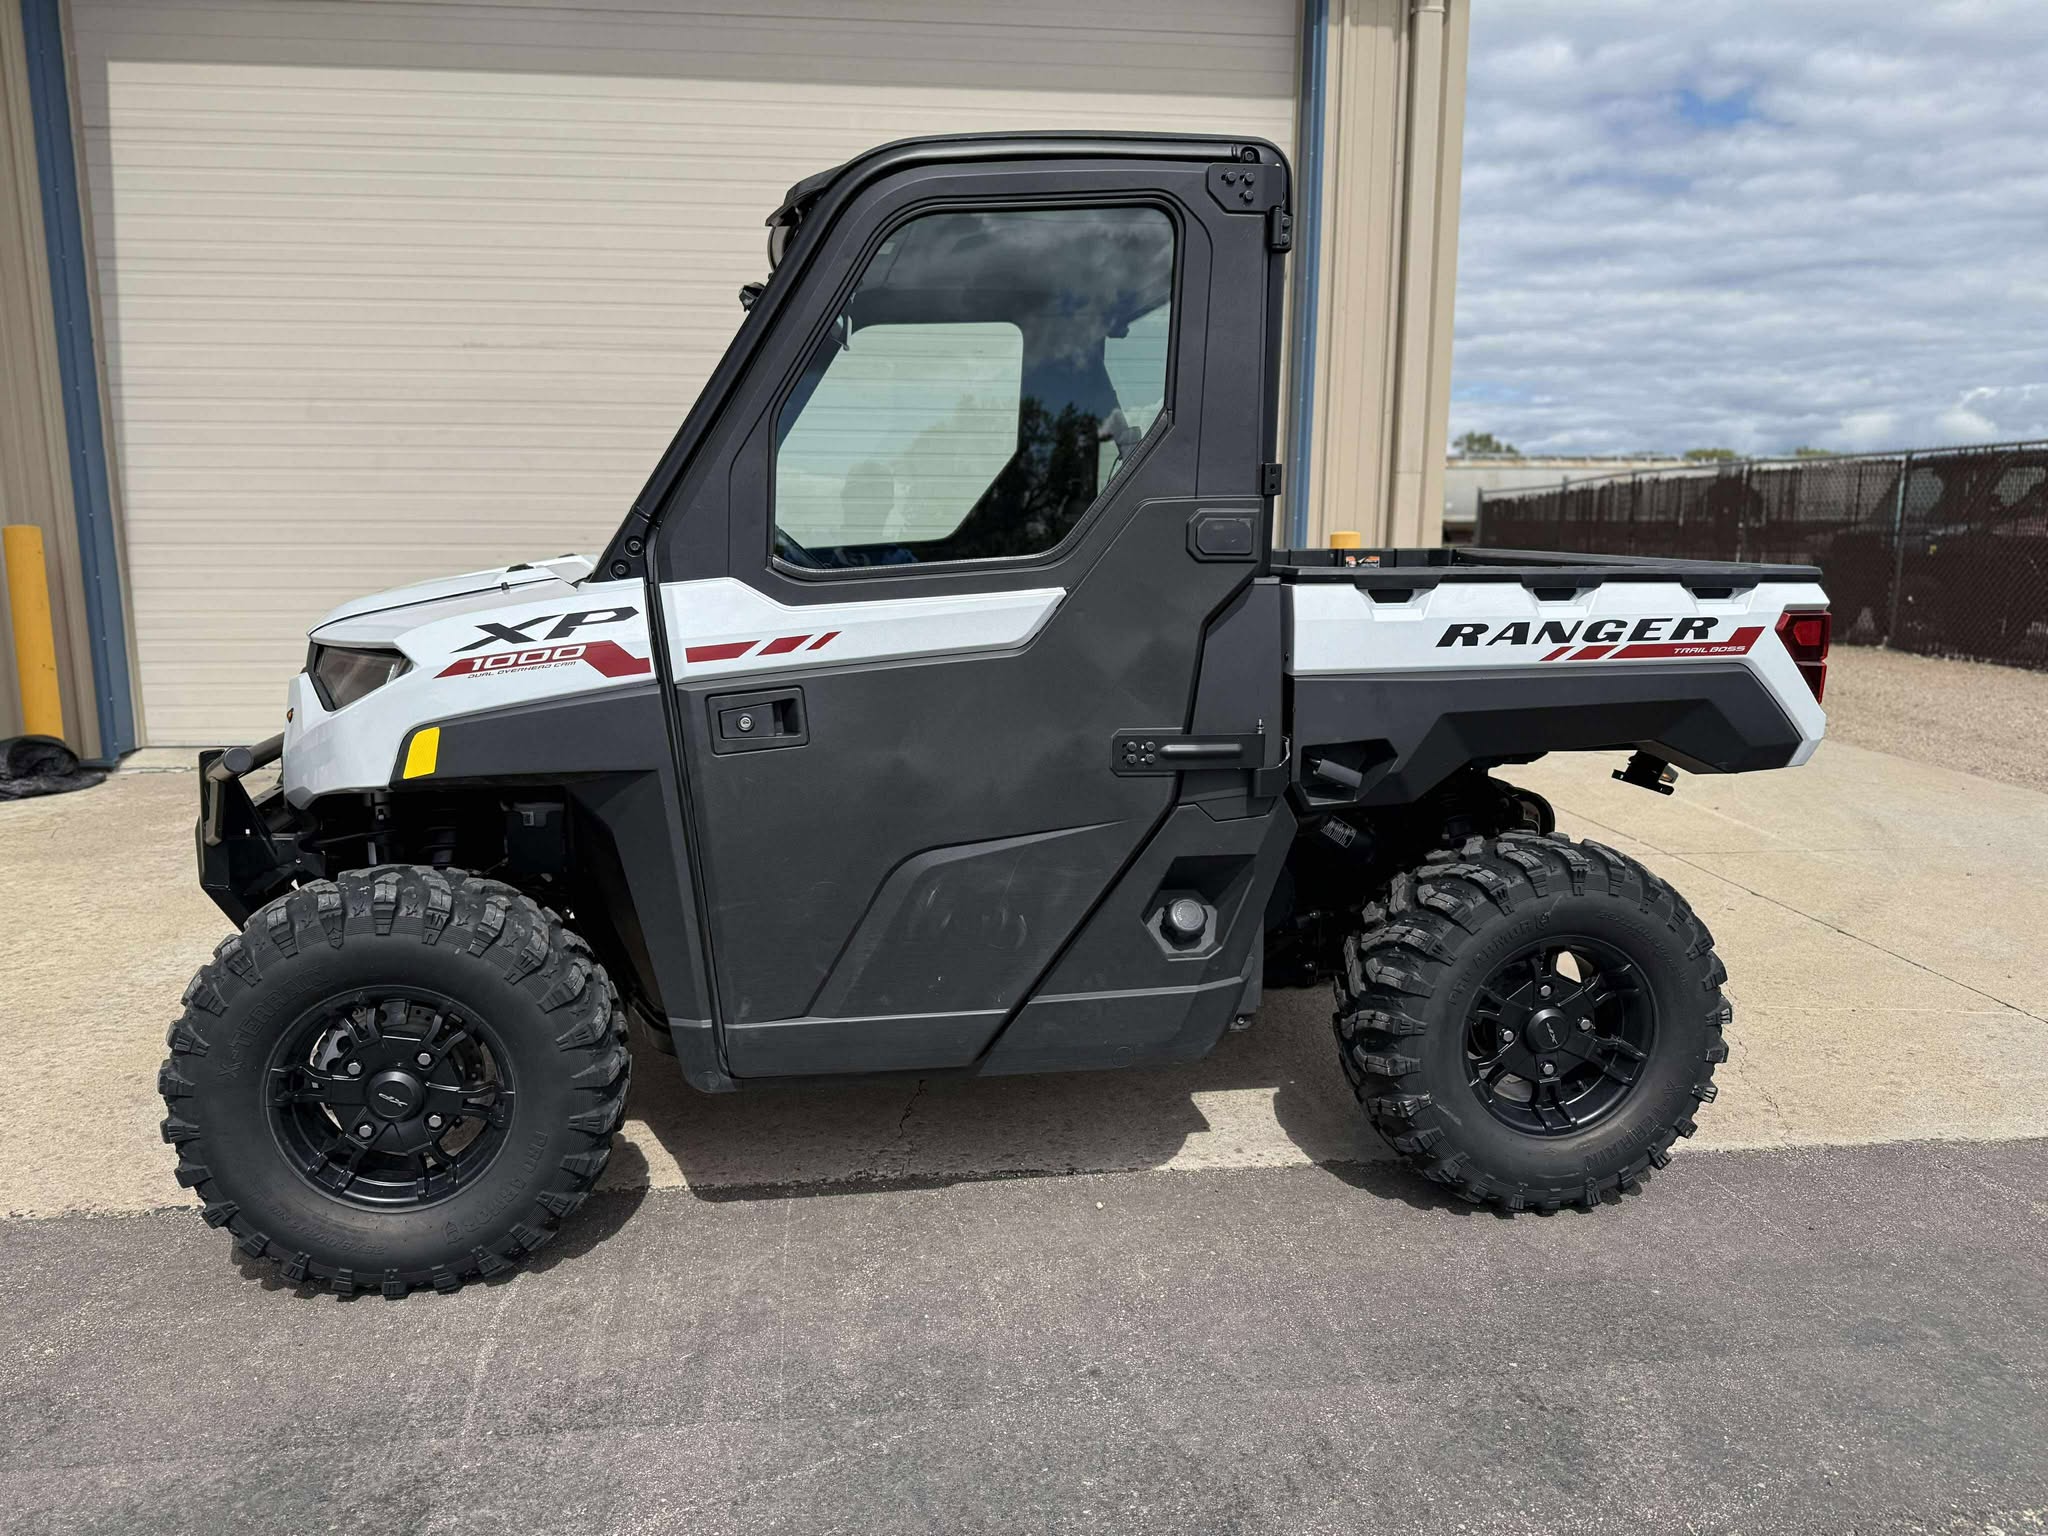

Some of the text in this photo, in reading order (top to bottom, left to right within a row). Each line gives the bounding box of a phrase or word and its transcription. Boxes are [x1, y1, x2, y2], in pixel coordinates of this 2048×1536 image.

[450, 606, 639, 653] XP
[1436, 617, 1718, 647] RANGER
[471, 644, 587, 672] 1000
[1709, 645, 1746, 653] BOSS
[468, 660, 577, 679] DUAL OVERHEAD CAM
